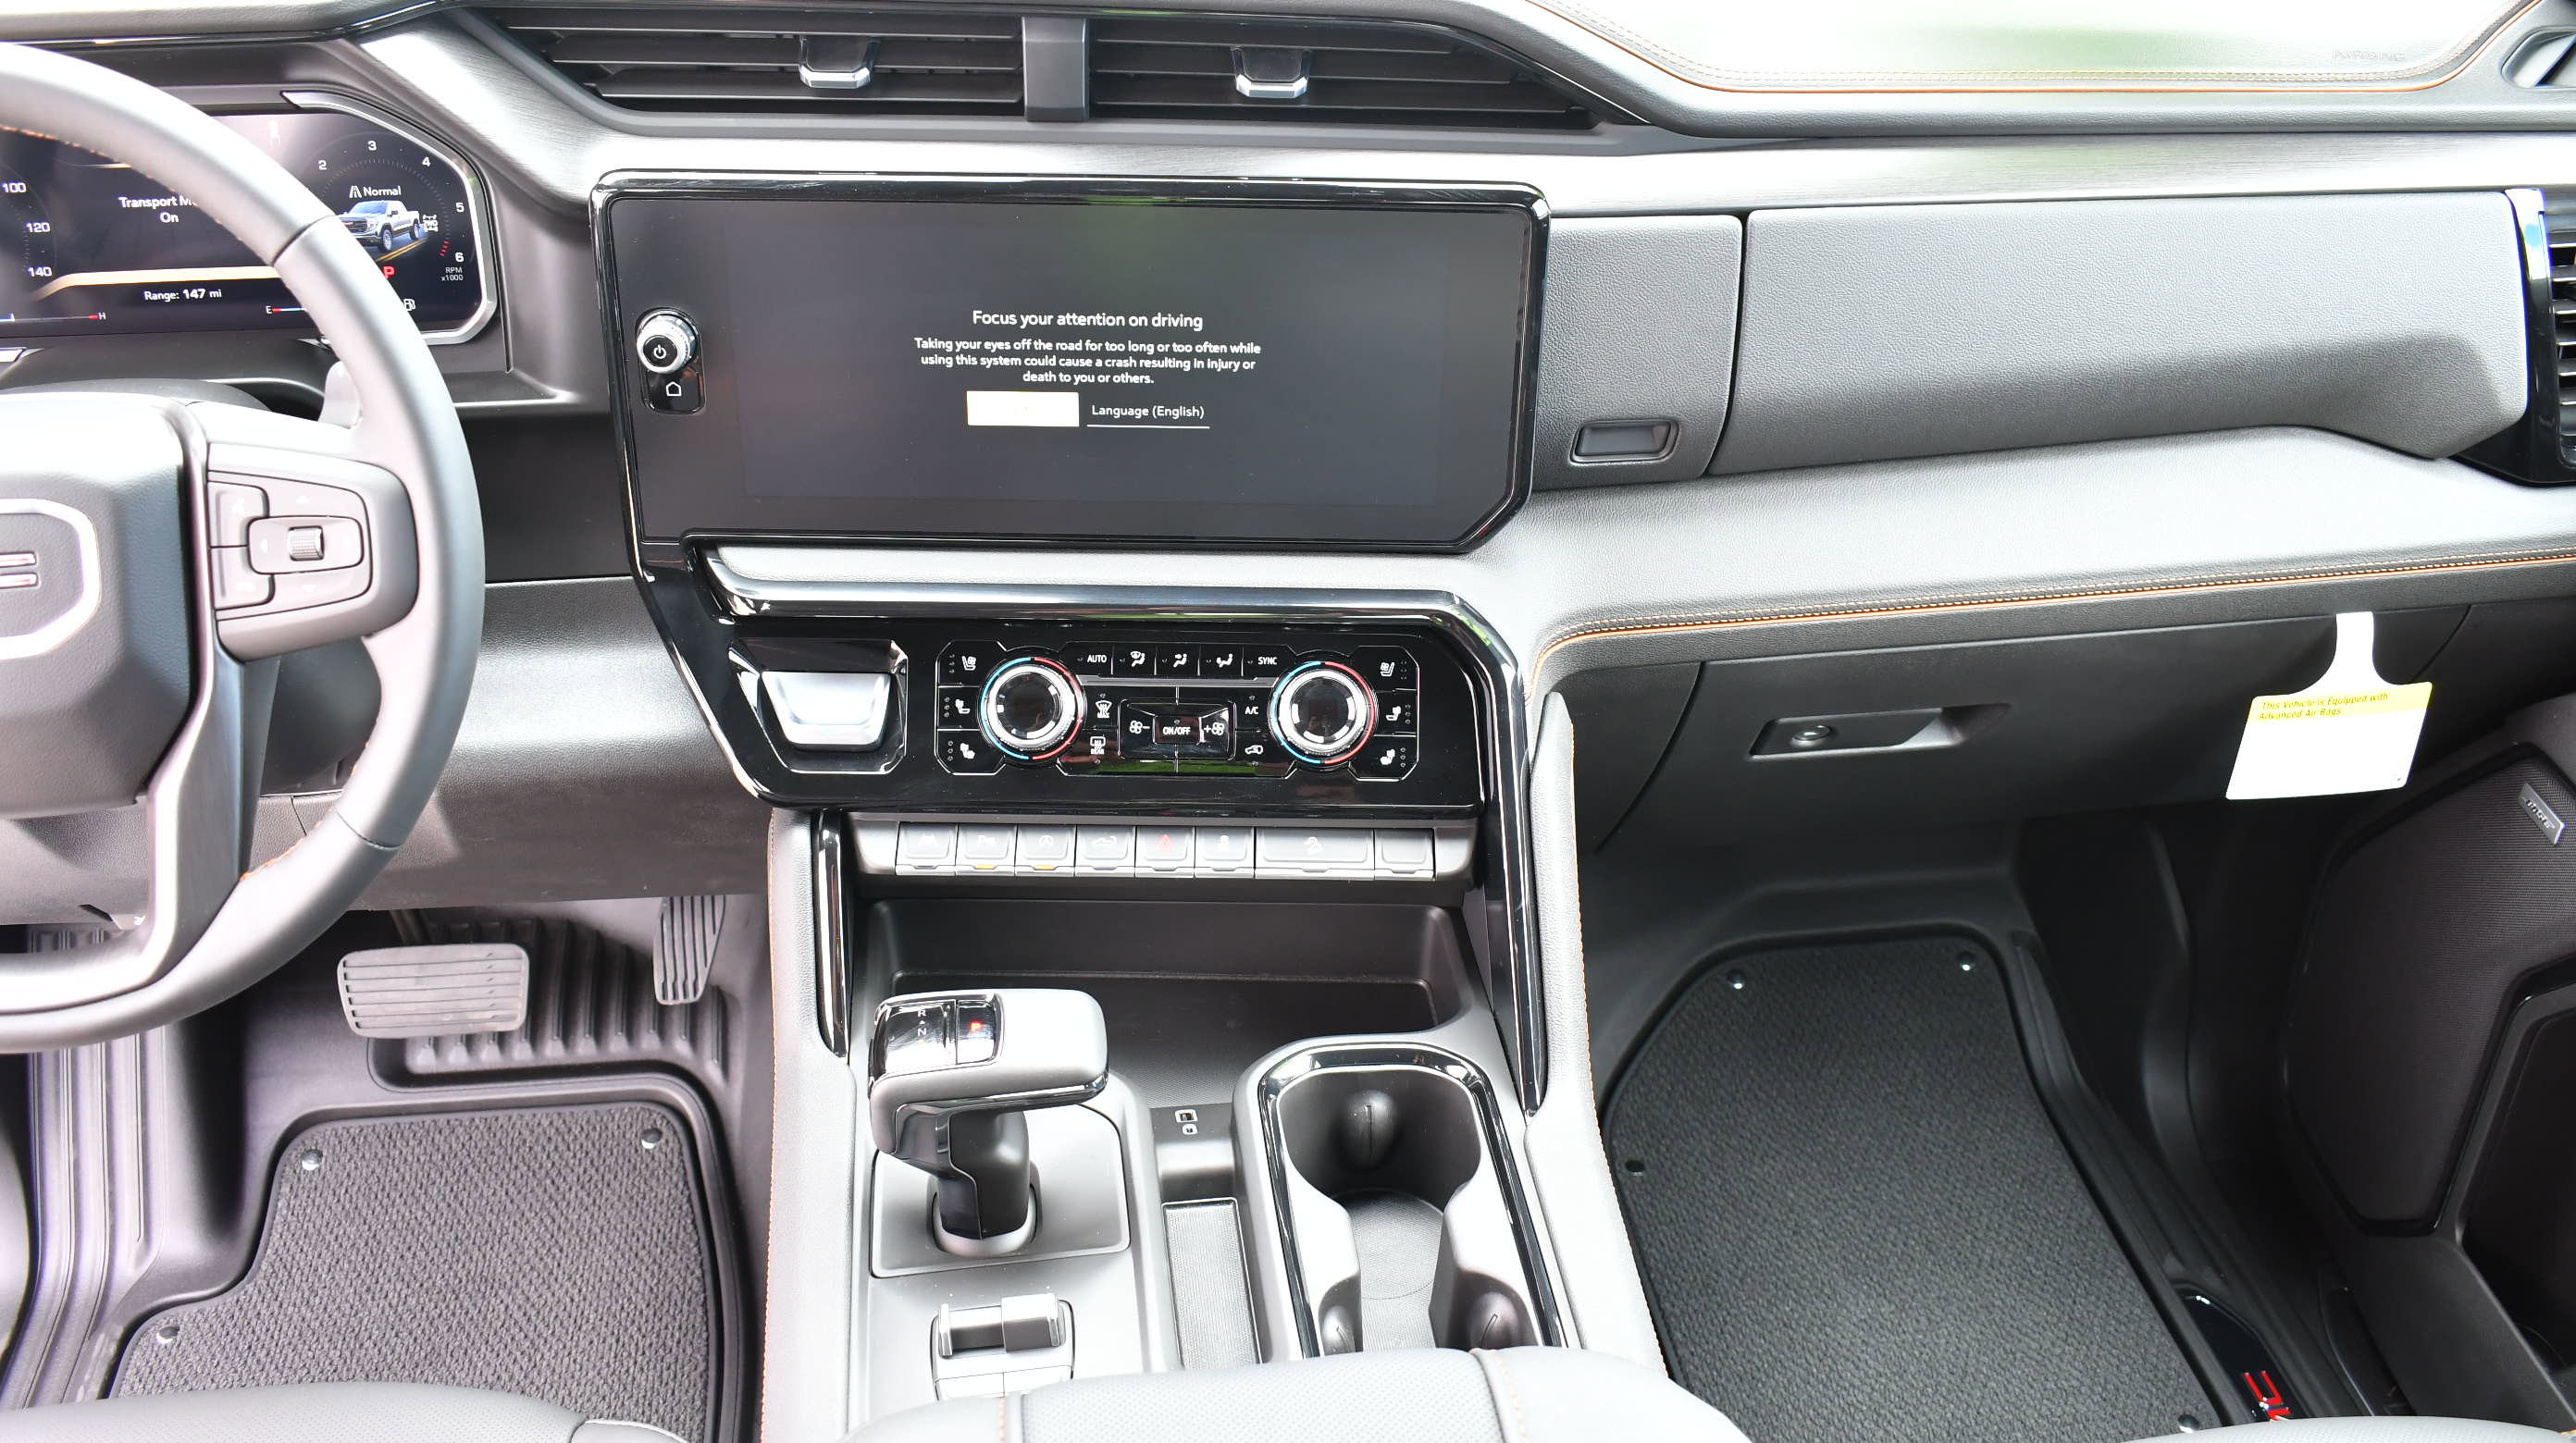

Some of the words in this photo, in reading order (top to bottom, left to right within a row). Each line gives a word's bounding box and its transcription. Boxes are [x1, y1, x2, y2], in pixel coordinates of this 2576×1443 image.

[367, 140, 378, 151] 3
[317, 159, 328, 171] 2
[421, 156, 431, 167] 4
[2, 181, 27, 193] 100
[363, 185, 402, 197] Normal
[118, 195, 179, 210] Transport
[455, 202, 464, 213] 5
[159, 211, 180, 224] On
[26, 222, 51, 233] 120
[454, 252, 464, 263] 6
[27, 266, 53, 278] 140
[382, 265, 396, 278] P
[441, 274, 464, 282] x1000
[143, 290, 180, 302] Range:
[182, 288, 206, 300] 147
[209, 289, 222, 298] mi
[266, 305, 272, 315] E
[98, 312, 106, 321] H
[972, 310, 1018, 326] Focus
[1020, 314, 1054, 329] your
[1056, 312, 1126, 327] attention
[1128, 315, 1148, 327] on
[1151, 312, 1203, 332] driving
[913, 337, 954, 352] Taking
[954, 340, 983, 352] your
[984, 340, 1011, 353] eyes
[1012, 338, 1033, 351] off
[1033, 339, 1054, 351] the
[1055, 339, 1083, 352] road
[1084, 339, 1104, 352] for
[1104, 340, 1126, 352] too
[1128, 339, 1155, 355] long
[1157, 343, 1170, 352] or
[1171, 341, 1194, 353] too
[1195, 340, 1228, 353] often
[1229, 341, 1261, 354] while
[921, 353, 954, 368] using
[955, 353, 978, 365] this
[979, 355, 1022, 369] system
[1023, 354, 1057, 366] could
[1058, 358, 1094, 367] cause
[1095, 358, 1103, 367] a
[1104, 355, 1137, 368] crash
[1139, 356, 1191, 372] resulting
[1193, 357, 1205, 369] in
[1207, 358, 1241, 373] injury
[1242, 361, 1257, 370] or
[1022, 370, 1057, 382] death
[1058, 372, 1072, 383] to
[1072, 374, 1096, 386] you
[1096, 374, 1111, 383] or
[1112, 371, 1155, 384] others.
[1092, 404, 1150, 419] Language
[1152, 404, 1205, 420] (English)
[1086, 654, 1108, 663] AUTO
[1257, 656, 1278, 665] SYNC
[2262, 700, 2280, 709] This
[2327, 695, 2367, 706] Equipped
[2370, 692, 2388, 701] with
[1245, 706, 1259, 715] A/C
[2259, 710, 2302, 721] Advanced
[2305, 709, 2316, 718] Air
[2320, 706, 2341, 717] Bags
[1162, 726, 1191, 735] ON/OFF
[917, 1028, 927, 1036] N
[971, 1021, 983, 1032] P
